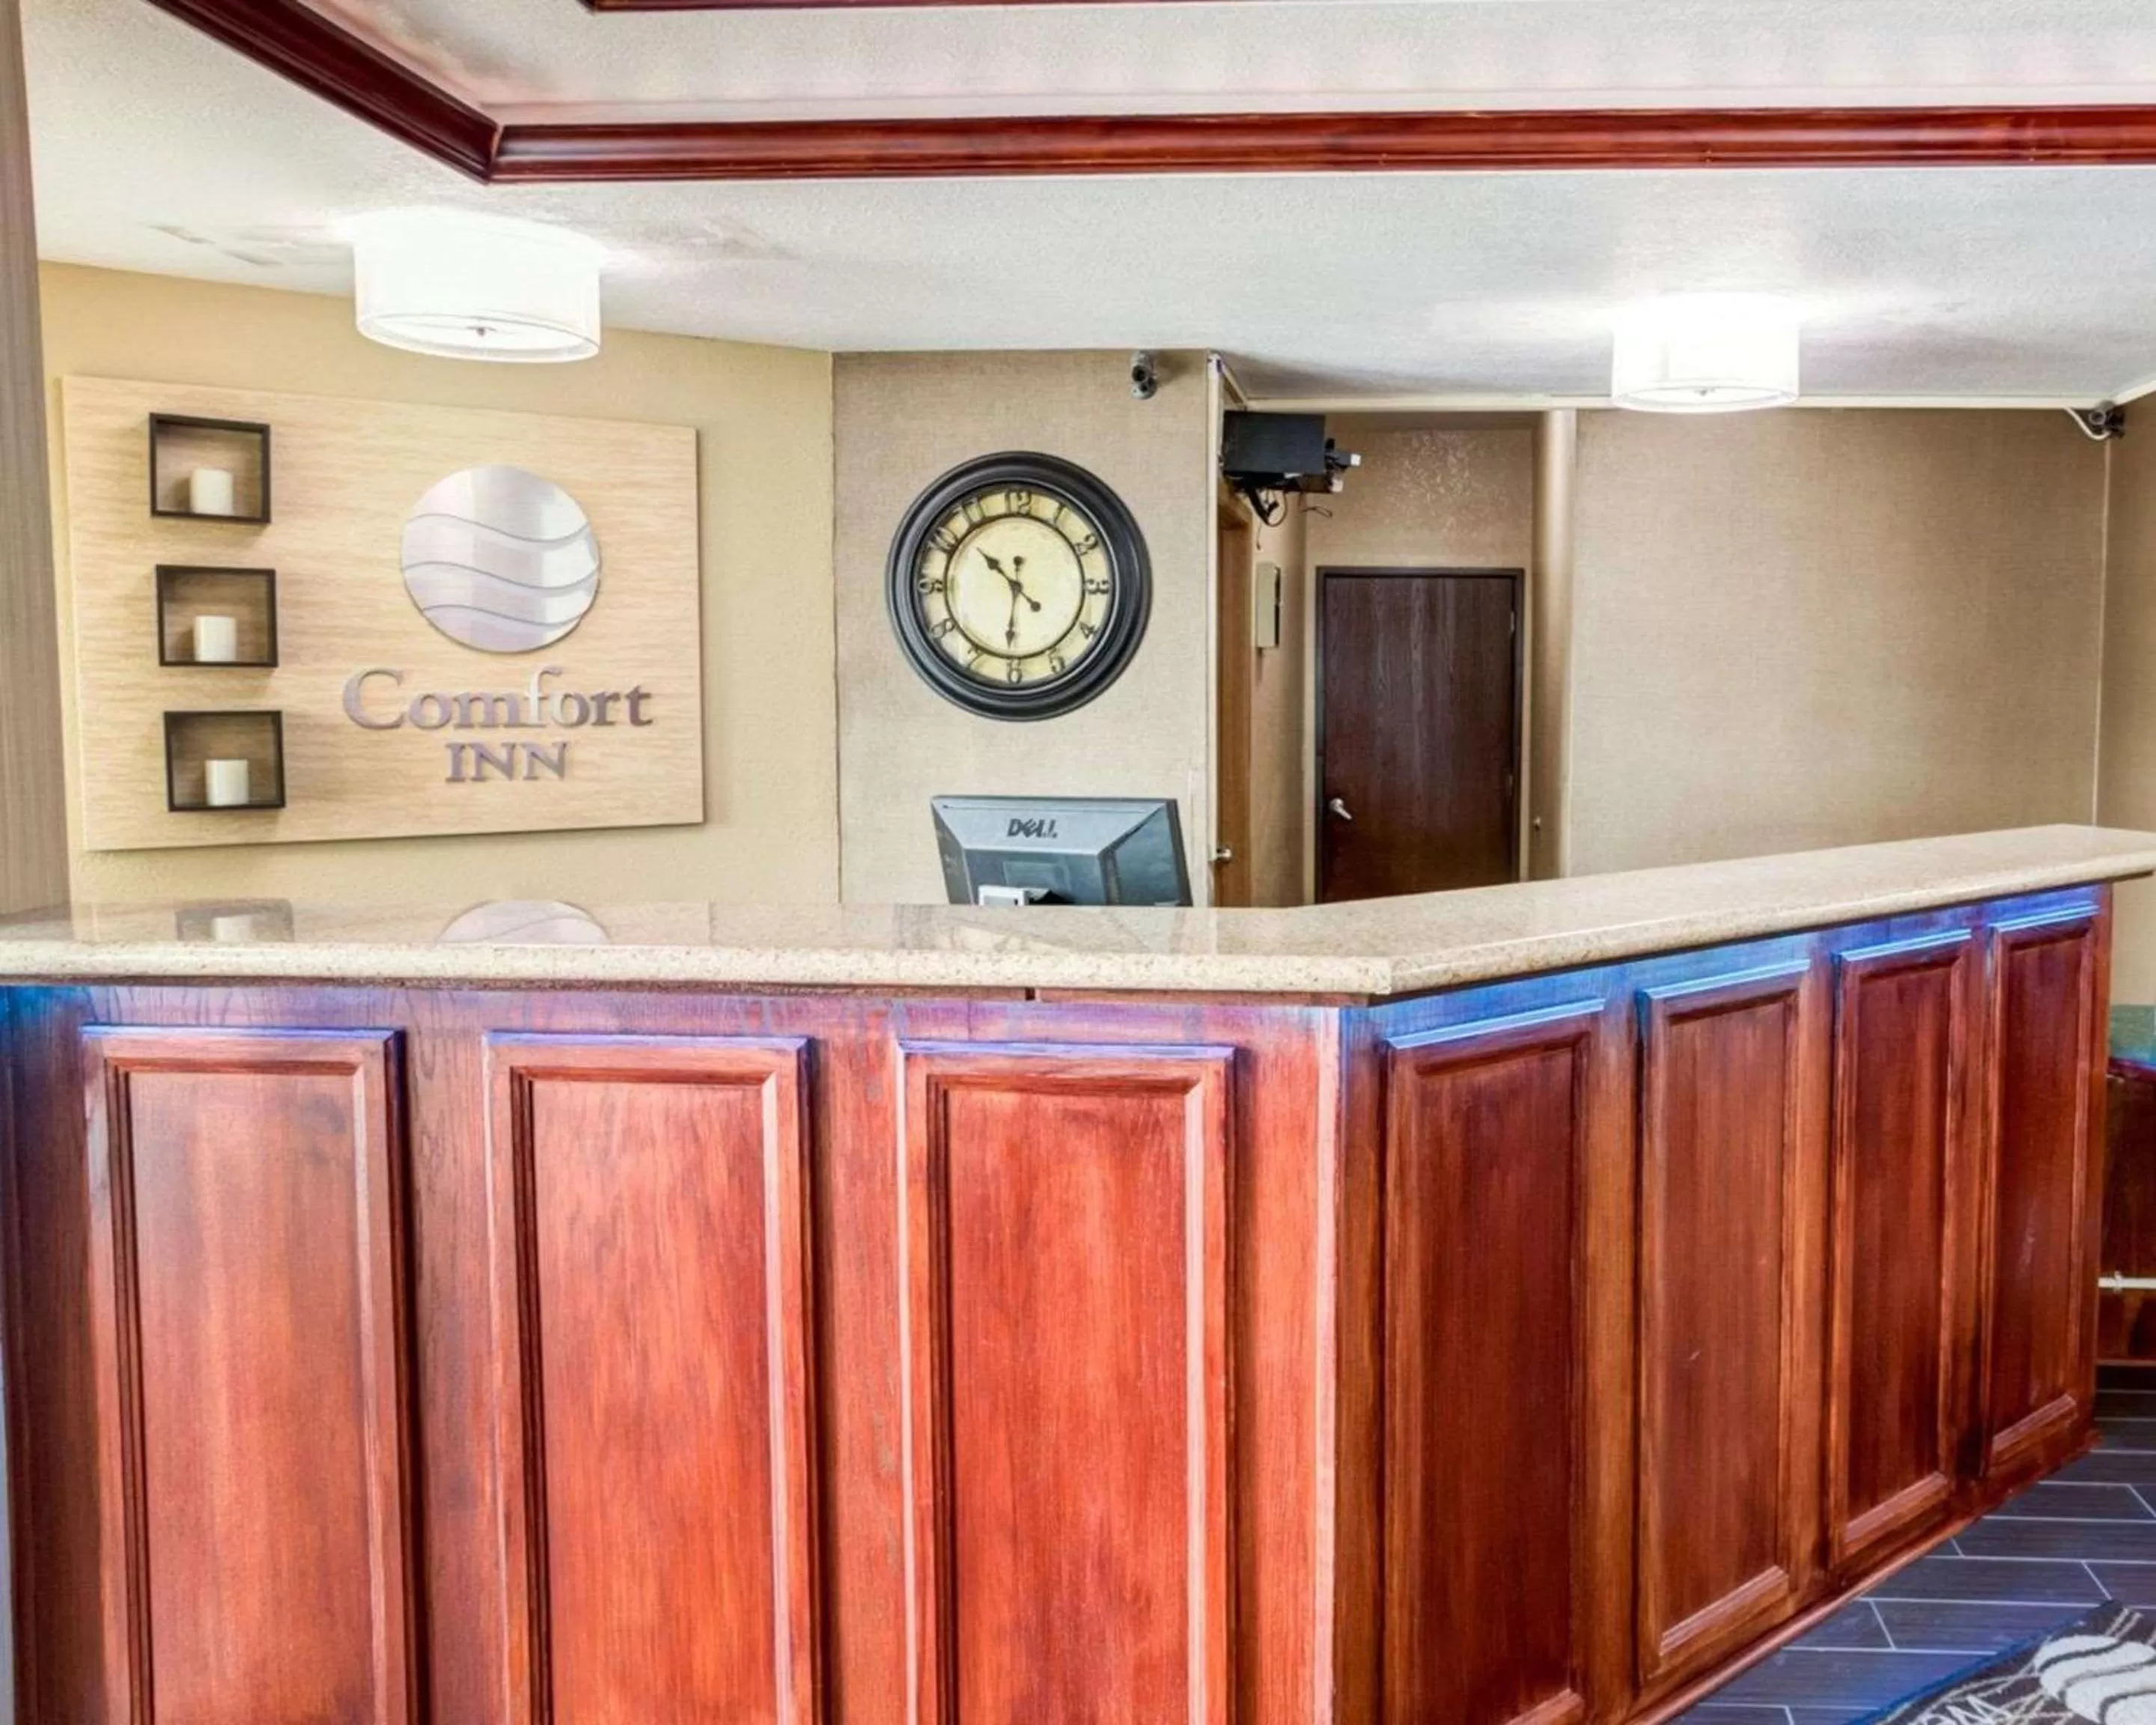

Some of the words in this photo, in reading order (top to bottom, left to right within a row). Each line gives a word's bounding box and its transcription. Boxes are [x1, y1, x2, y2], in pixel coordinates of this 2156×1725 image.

[1004, 489, 1032, 515] 12
[1077, 532, 1098, 556] 2
[919, 578, 943, 594] 9
[1085, 578, 1109, 594] 3
[931, 618, 956, 639] 8
[1079, 621, 1098, 639] 4
[966, 645, 984, 670] 7
[1048, 647, 1066, 674] 5
[1006, 658, 1023, 684] 6
[343, 665, 653, 730] Comfort
[445, 741, 567, 782] INN
[1007, 818, 1058, 838] DELL
